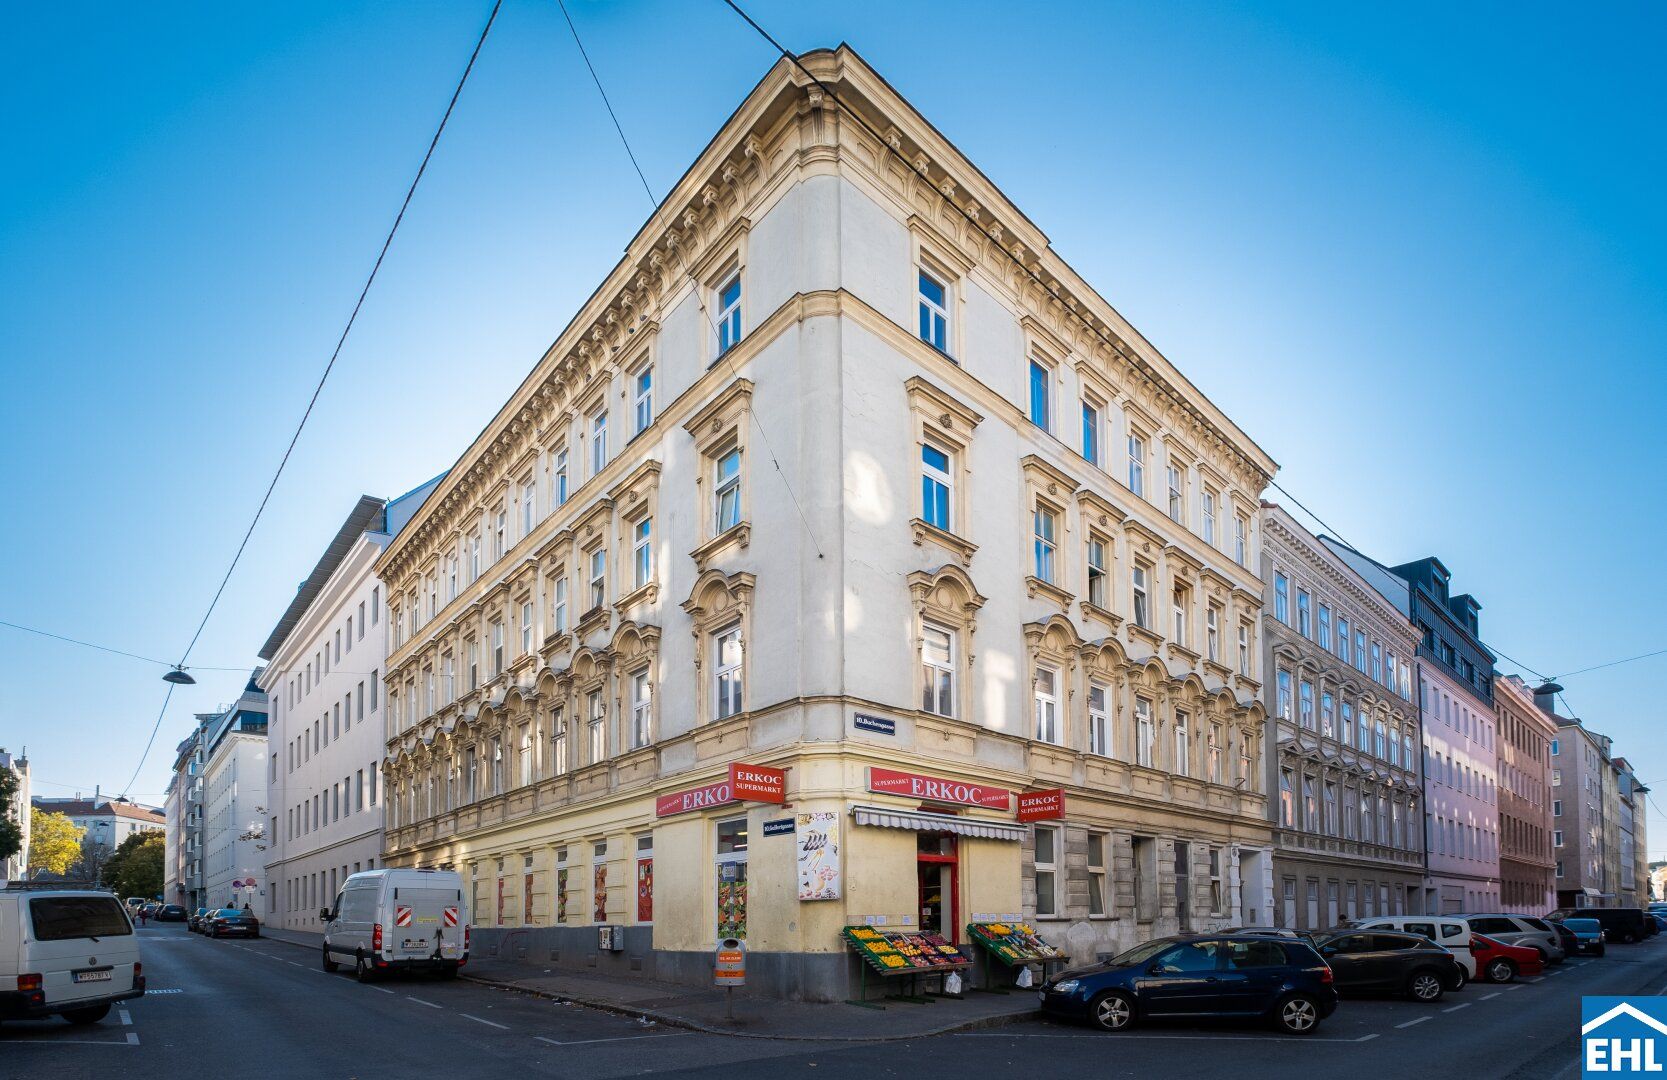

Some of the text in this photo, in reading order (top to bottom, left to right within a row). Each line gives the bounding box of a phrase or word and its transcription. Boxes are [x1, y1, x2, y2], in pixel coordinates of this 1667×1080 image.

[737, 771, 782, 785] ERKOC
[736, 783, 782, 794] SUPERMARKT
[874, 778, 909, 787] SUPERMARKT
[911, 777, 982, 804] ERKOC
[1021, 795, 1059, 807] ERKOC
[1020, 805, 1059, 814] SUPERMARKT
